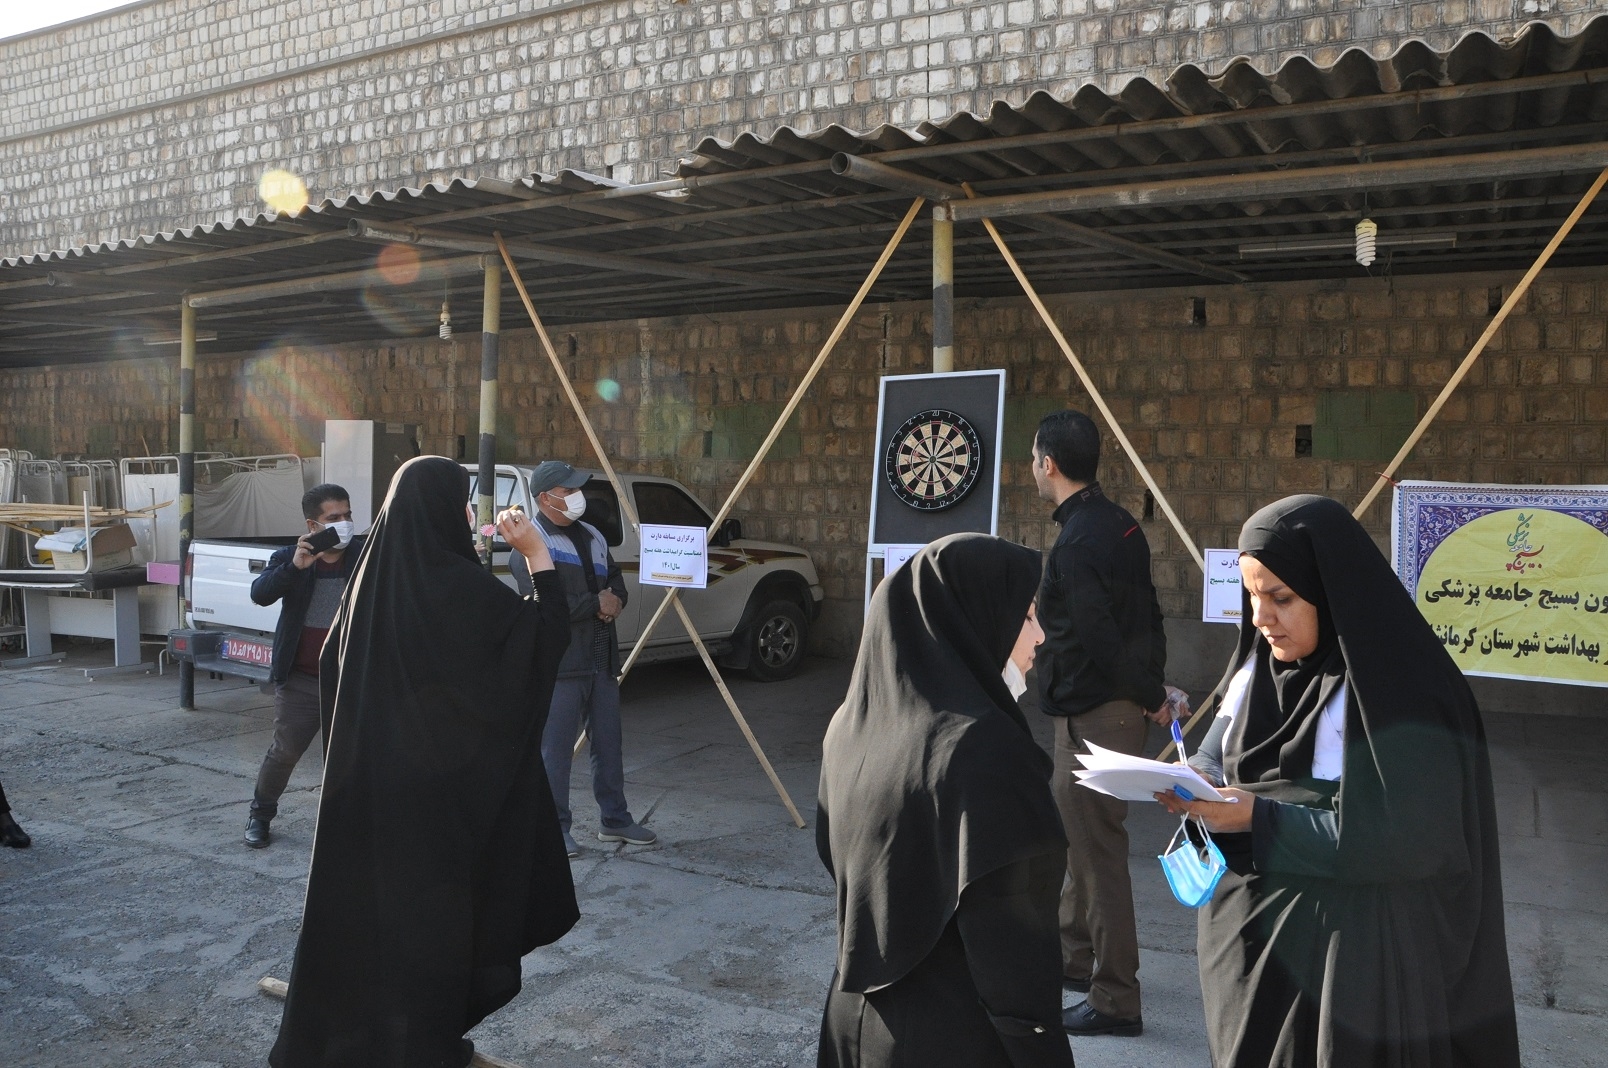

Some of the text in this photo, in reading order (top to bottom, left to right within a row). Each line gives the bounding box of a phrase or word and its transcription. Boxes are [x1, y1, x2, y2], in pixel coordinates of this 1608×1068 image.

[1425, 578, 1480, 606] پزشکی
[1484, 582, 1534, 608] جامعه
[1538, 590, 1580, 610] بسیج
[1480, 627, 1540, 658] شهرستان
[1544, 632, 1600, 664] بهداشت
